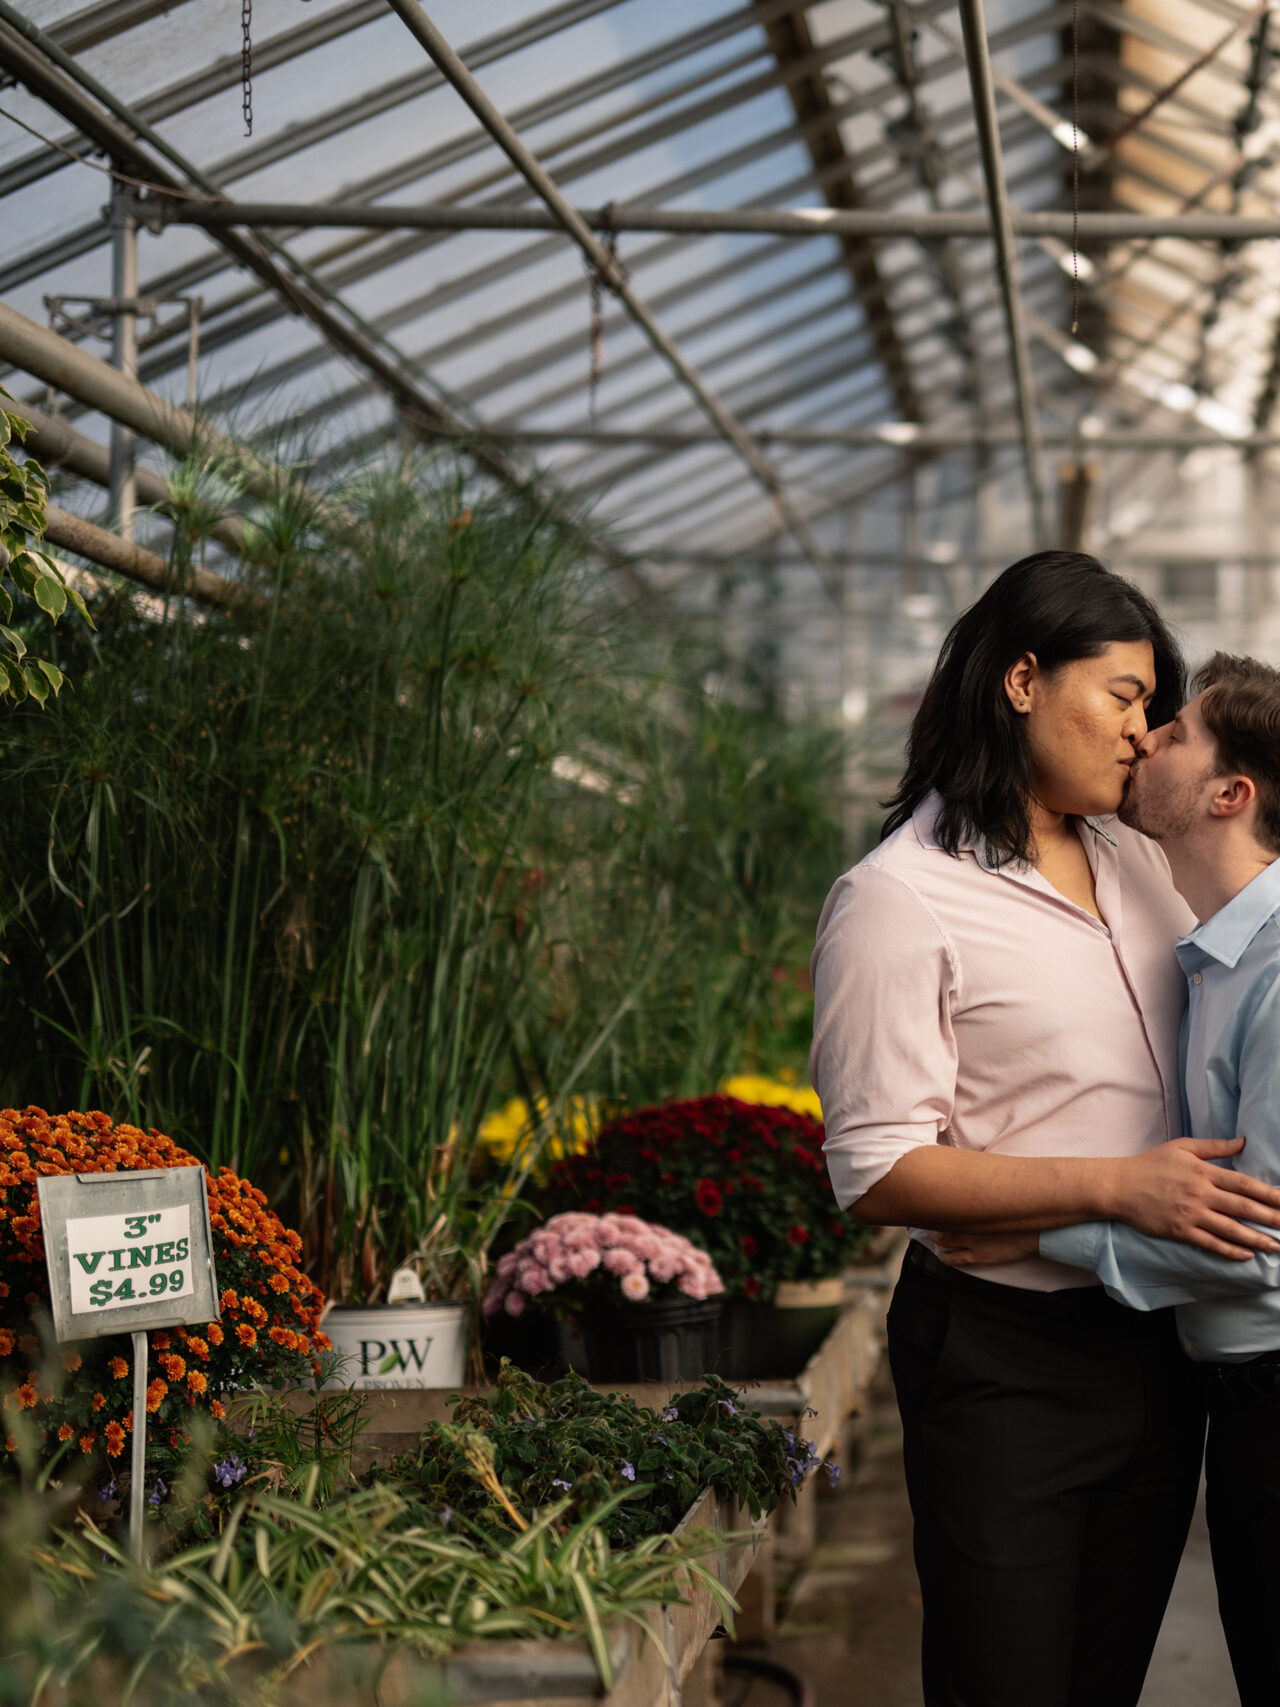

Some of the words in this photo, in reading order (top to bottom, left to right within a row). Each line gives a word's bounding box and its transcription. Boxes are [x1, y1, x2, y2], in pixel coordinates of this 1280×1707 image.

[123, 1213, 162, 1239] 3"
[73, 1237, 189, 1275] VINES
[89, 1269, 184, 1306] $4.99
[358, 1336, 434, 1376] PW
